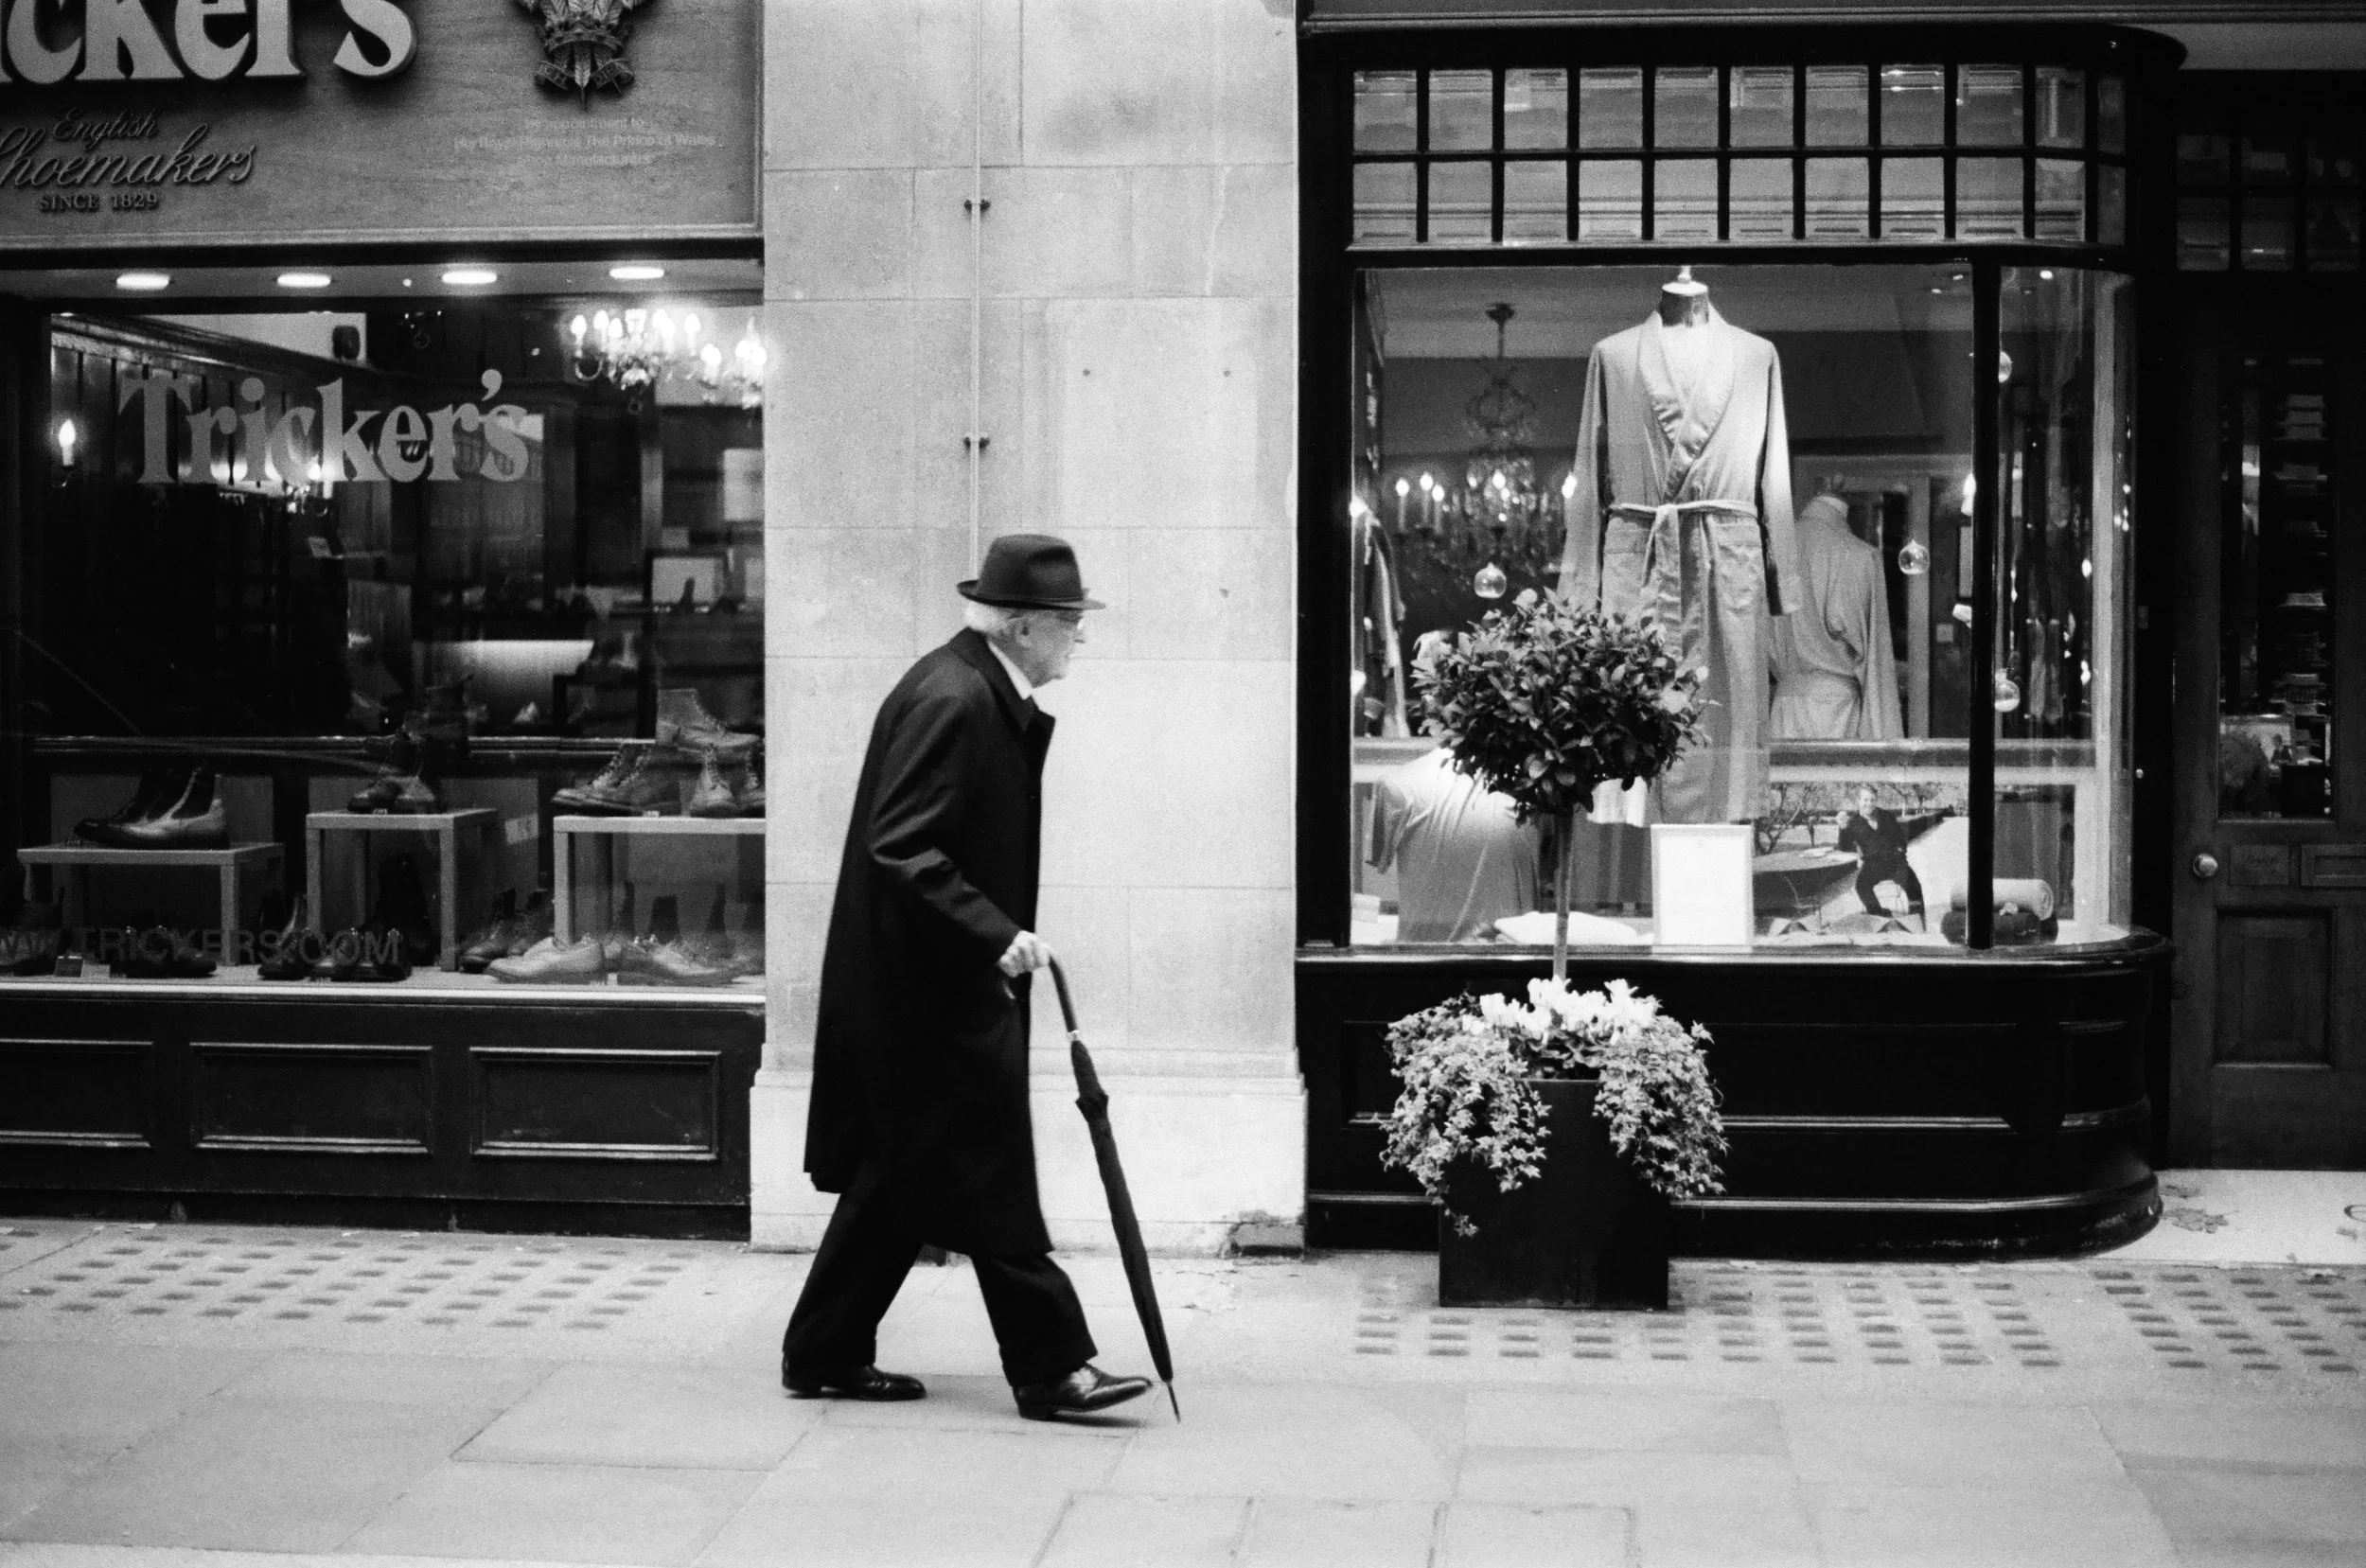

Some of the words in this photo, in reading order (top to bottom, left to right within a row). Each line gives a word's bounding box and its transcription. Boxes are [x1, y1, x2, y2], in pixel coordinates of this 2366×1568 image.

[0, 0, 414, 84] ckers
[52, 106, 161, 151] English
[40, 193, 98, 212] SINCE
[111, 192, 159, 211] 1829
[117, 368, 530, 484] Tricker's
